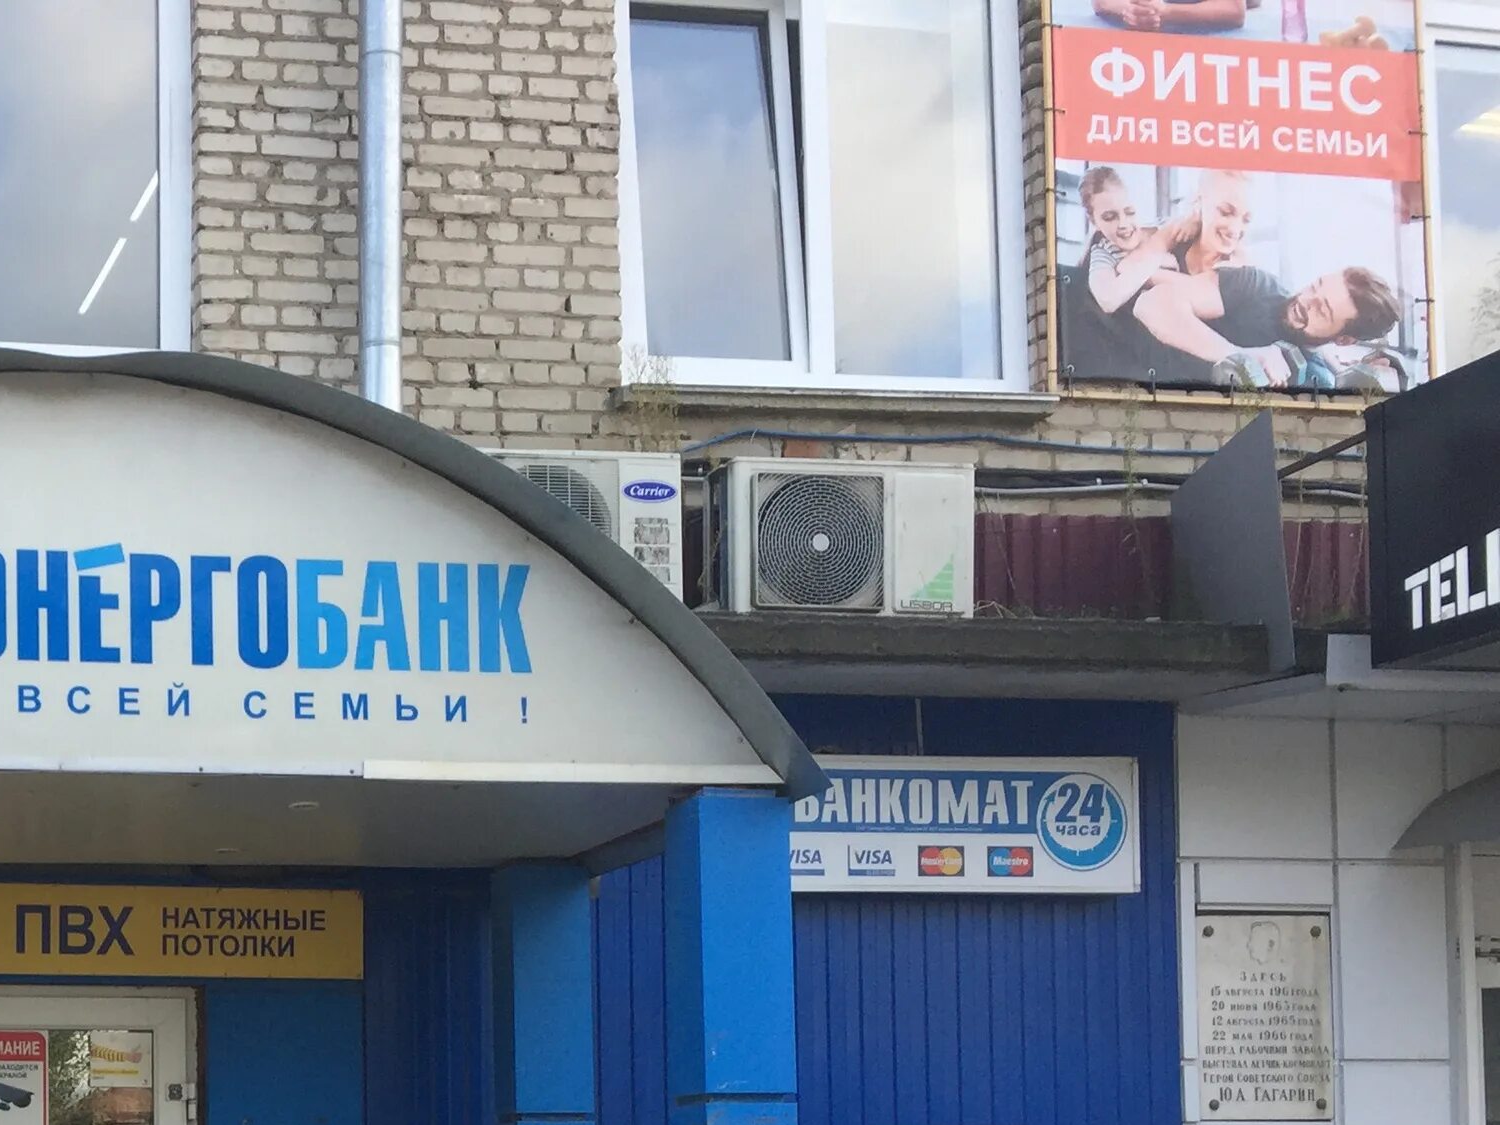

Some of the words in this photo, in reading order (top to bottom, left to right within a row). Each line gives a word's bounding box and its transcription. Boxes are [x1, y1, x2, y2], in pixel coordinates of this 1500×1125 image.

[1090, 47, 1383, 116] ФИТНЕС
[1086, 114, 1159, 145] ДЛЯ
[1171, 119, 1260, 149] ВСЕЙ
[1272, 126, 1388, 158] СЕМЬИ
[630, 485, 671, 496] Carrier
[18, 683, 192, 718] ВСЕЙ
[243, 694, 470, 724] СЕМЬИ
[1054, 782, 1105, 824] 24
[1055, 824, 1102, 837] часа
[854, 850, 893, 865] VISA
[992, 856, 1030, 866] Maestro
[14, 903, 136, 957] ПВХ
[161, 906, 328, 933] НАТЯЖНЫЕ
[160, 934, 297, 960] ПОТОЛКИ
[1211, 1000, 1225, 1012] 20
[1212, 1015, 1223, 1026] 12
[1212, 1030, 1226, 1041] 22
[1259, 1030, 1287, 1041] 1966
[1254, 1086, 1316, 1102] ГАГАРИН
